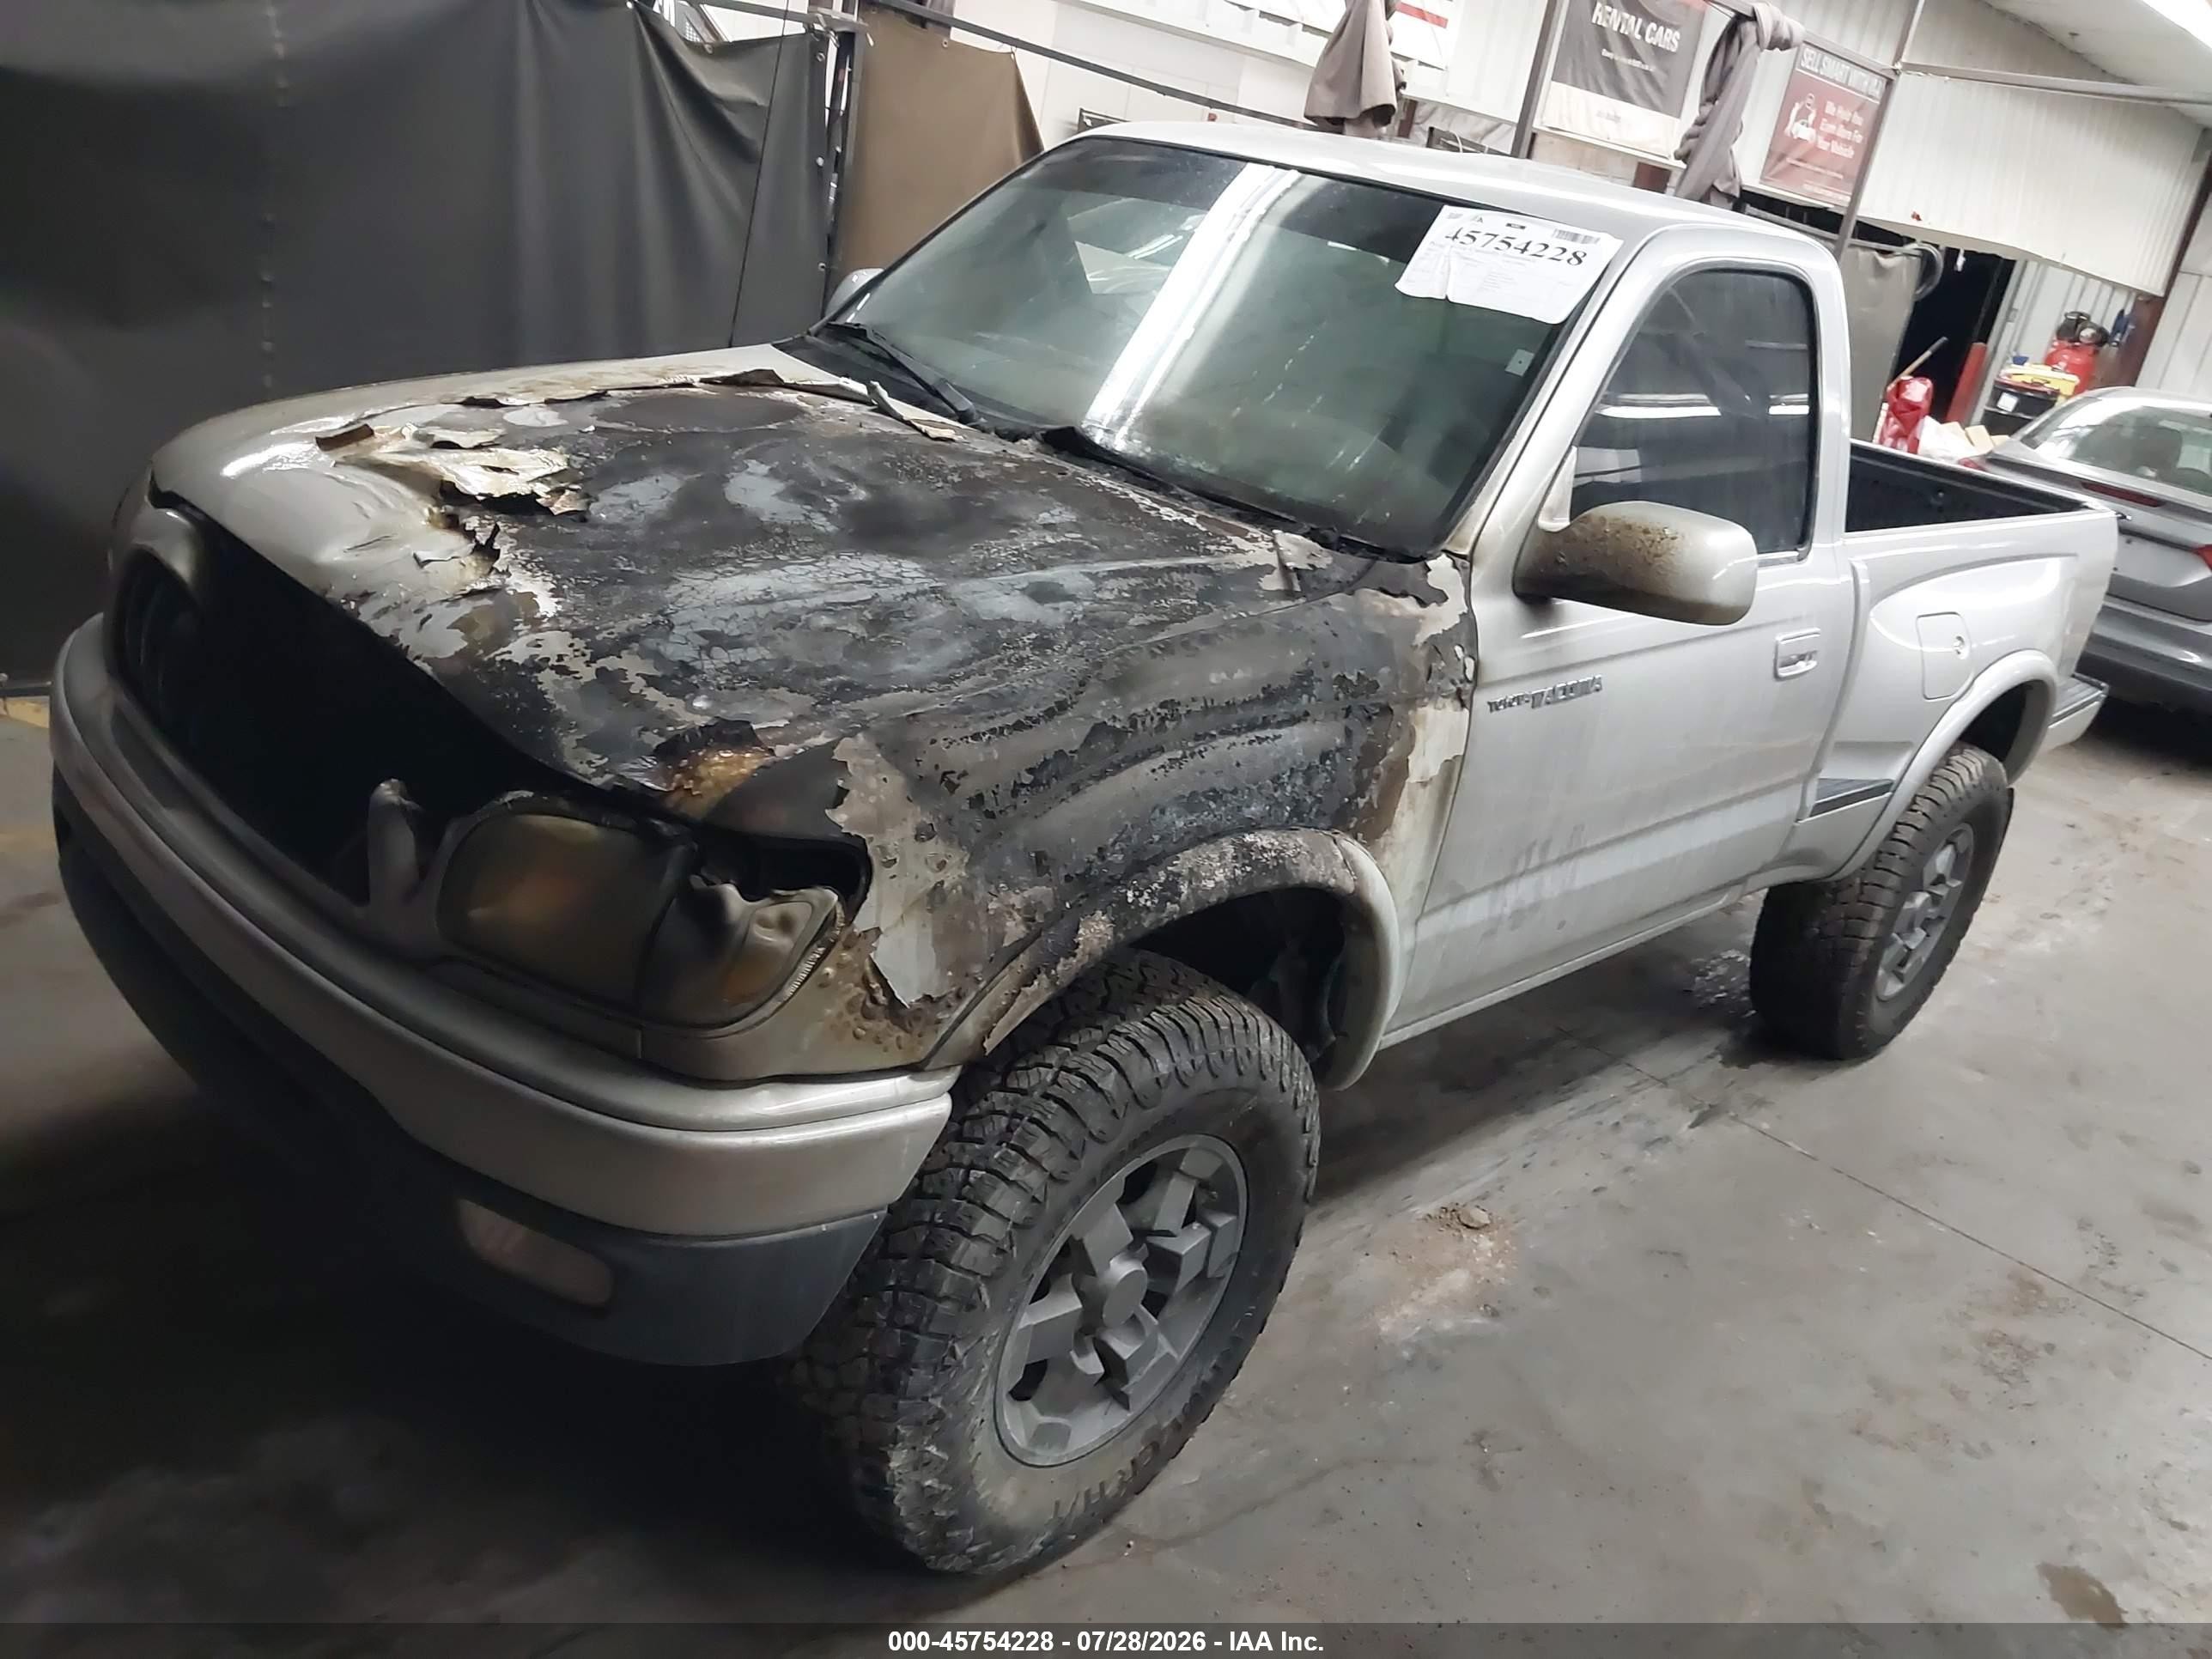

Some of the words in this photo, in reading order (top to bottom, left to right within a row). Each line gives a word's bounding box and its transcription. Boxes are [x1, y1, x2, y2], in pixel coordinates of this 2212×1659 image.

[1591, 2, 1643, 40] RENTAL
[1644, 21, 1681, 52] CARS
[1444, 227, 1588, 267] 45754228
